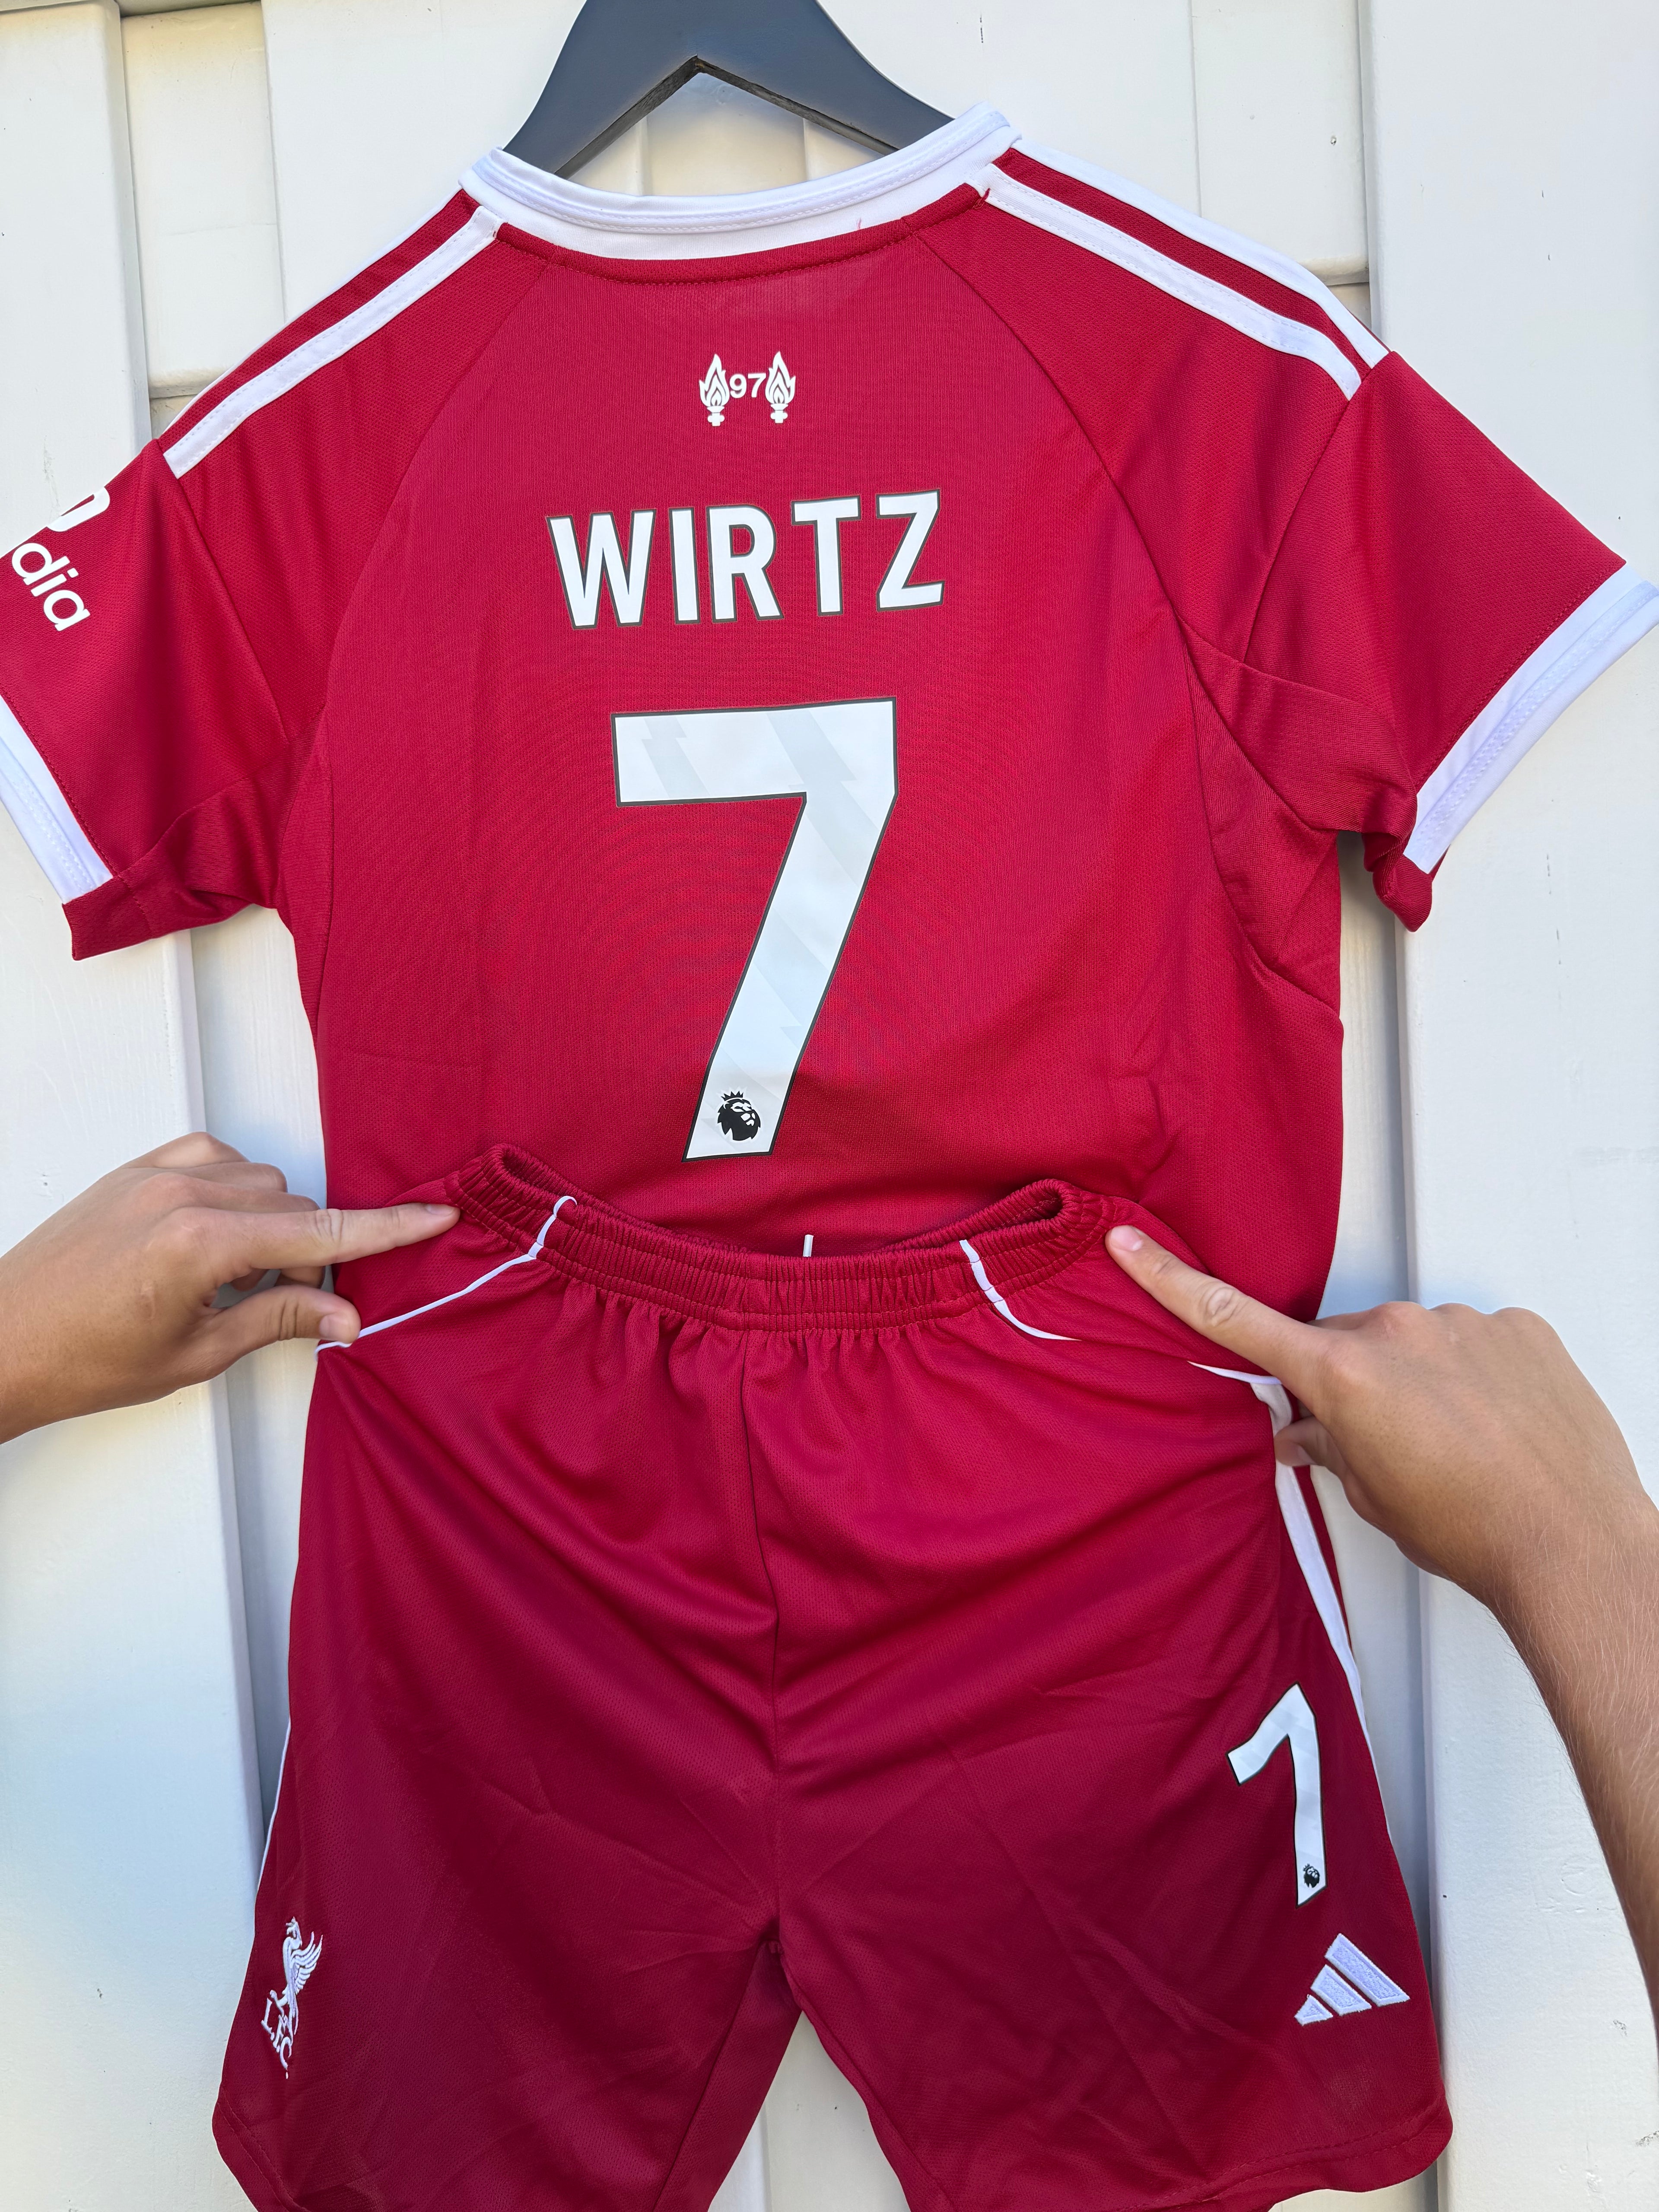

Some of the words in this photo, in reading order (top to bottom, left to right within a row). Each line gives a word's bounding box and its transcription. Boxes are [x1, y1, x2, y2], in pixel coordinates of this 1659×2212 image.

[729, 372, 766, 398] 97
[547, 489, 945, 630] WIRTZ
[611, 697, 898, 1163] 7
[1225, 1681, 1327, 1908] 7
